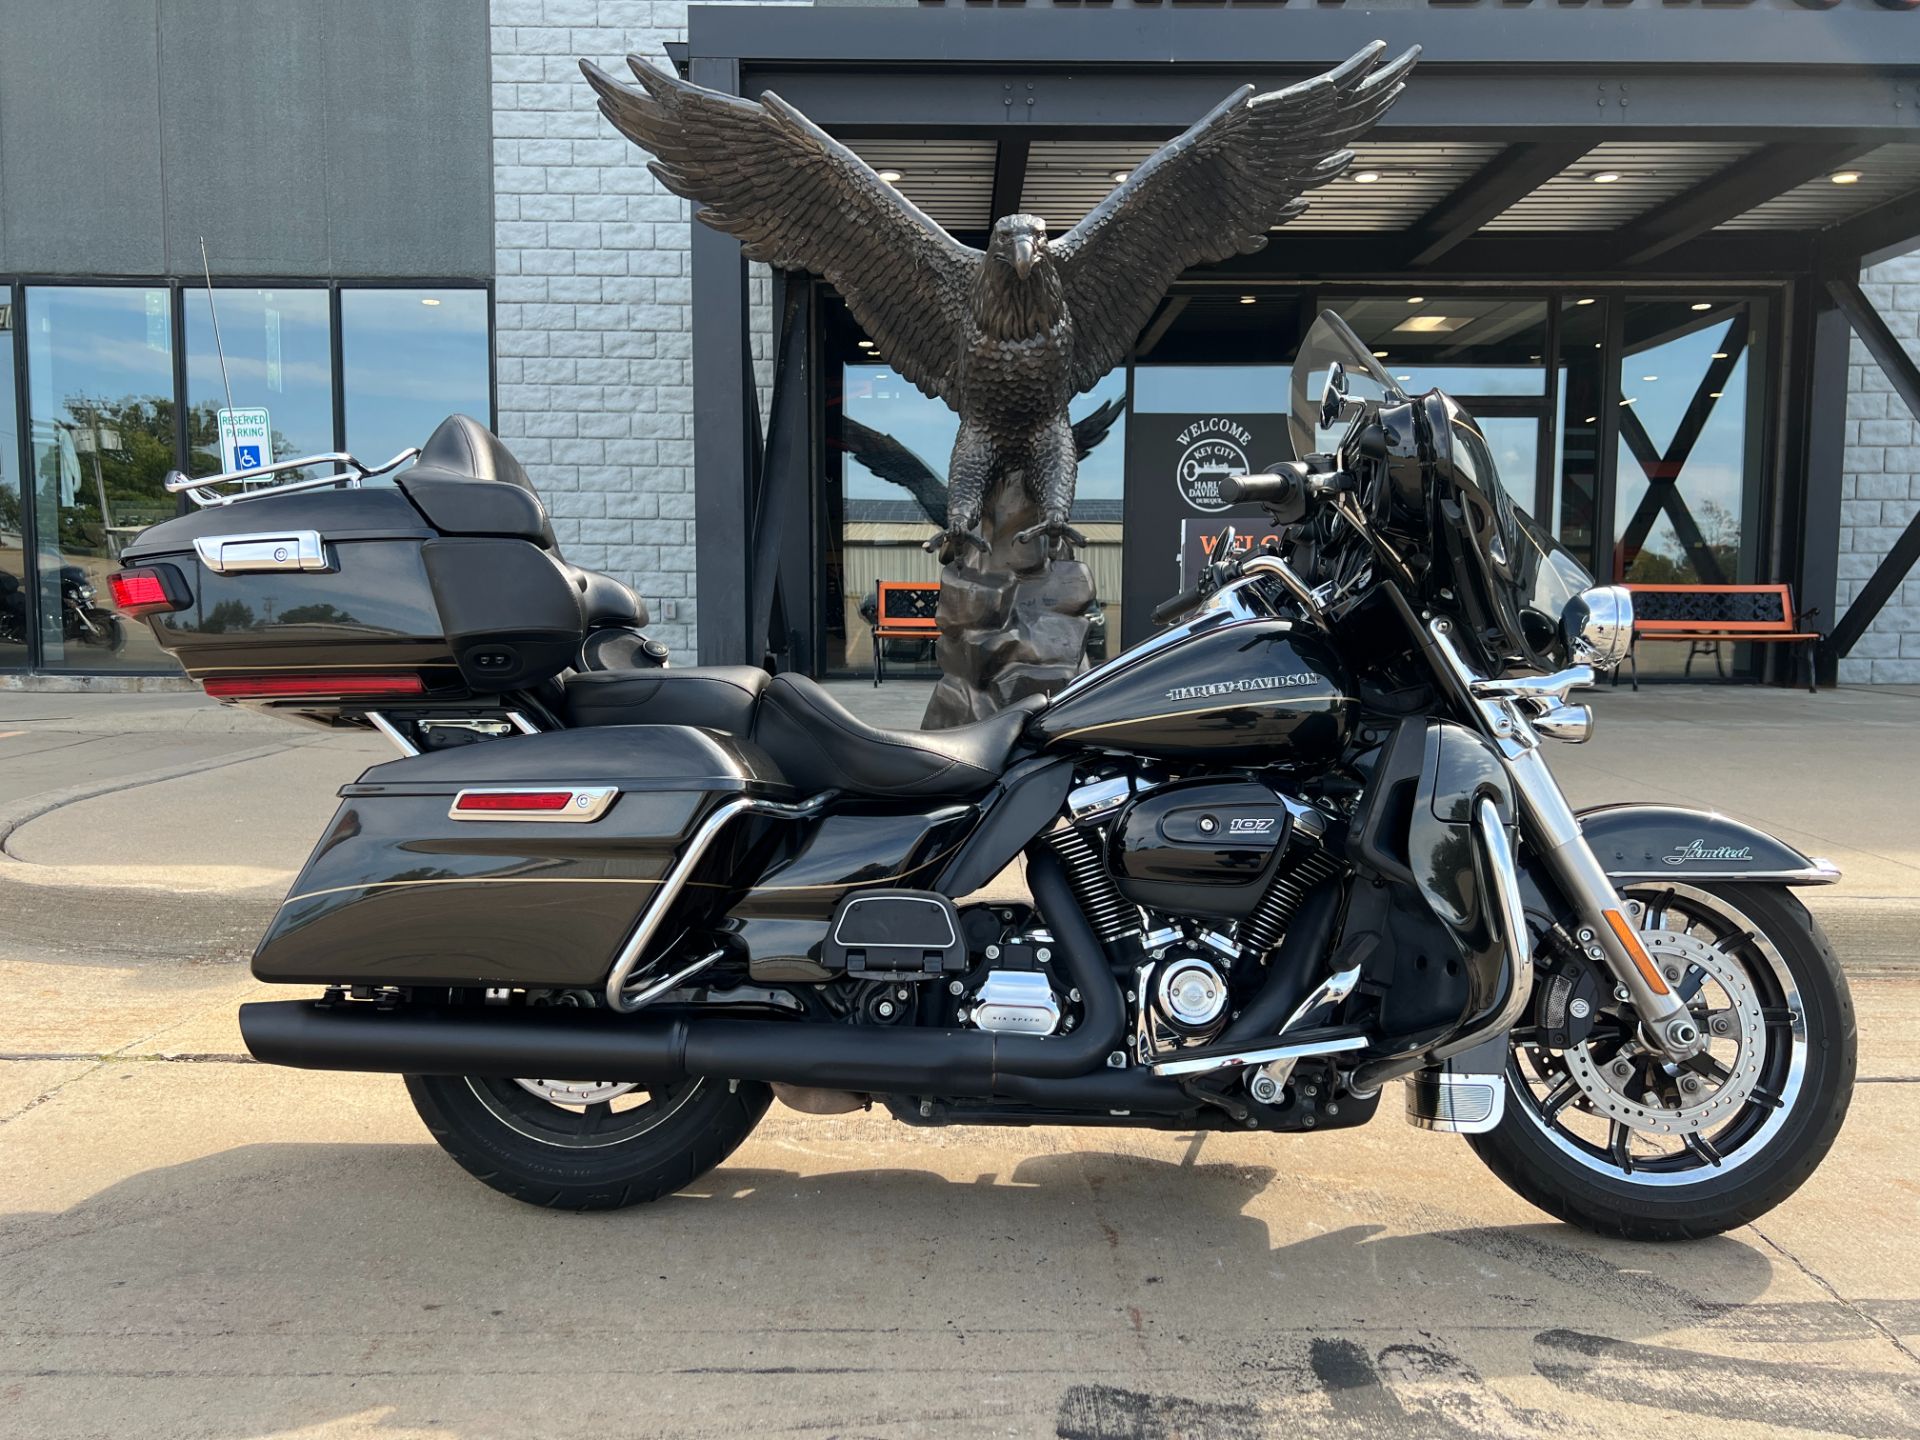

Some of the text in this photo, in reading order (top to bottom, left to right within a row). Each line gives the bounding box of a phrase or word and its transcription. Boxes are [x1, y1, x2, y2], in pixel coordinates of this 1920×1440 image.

[222, 415, 266, 426] RESERVED
[226, 428, 264, 438] PARKING
[1176, 417, 1252, 446] WELCOME
[1193, 445, 1237, 460] KEY CITY
[1194, 481, 1221, 490] HARL
[1230, 818, 1275, 830] 107
[1662, 838, 1753, 865] Limited
